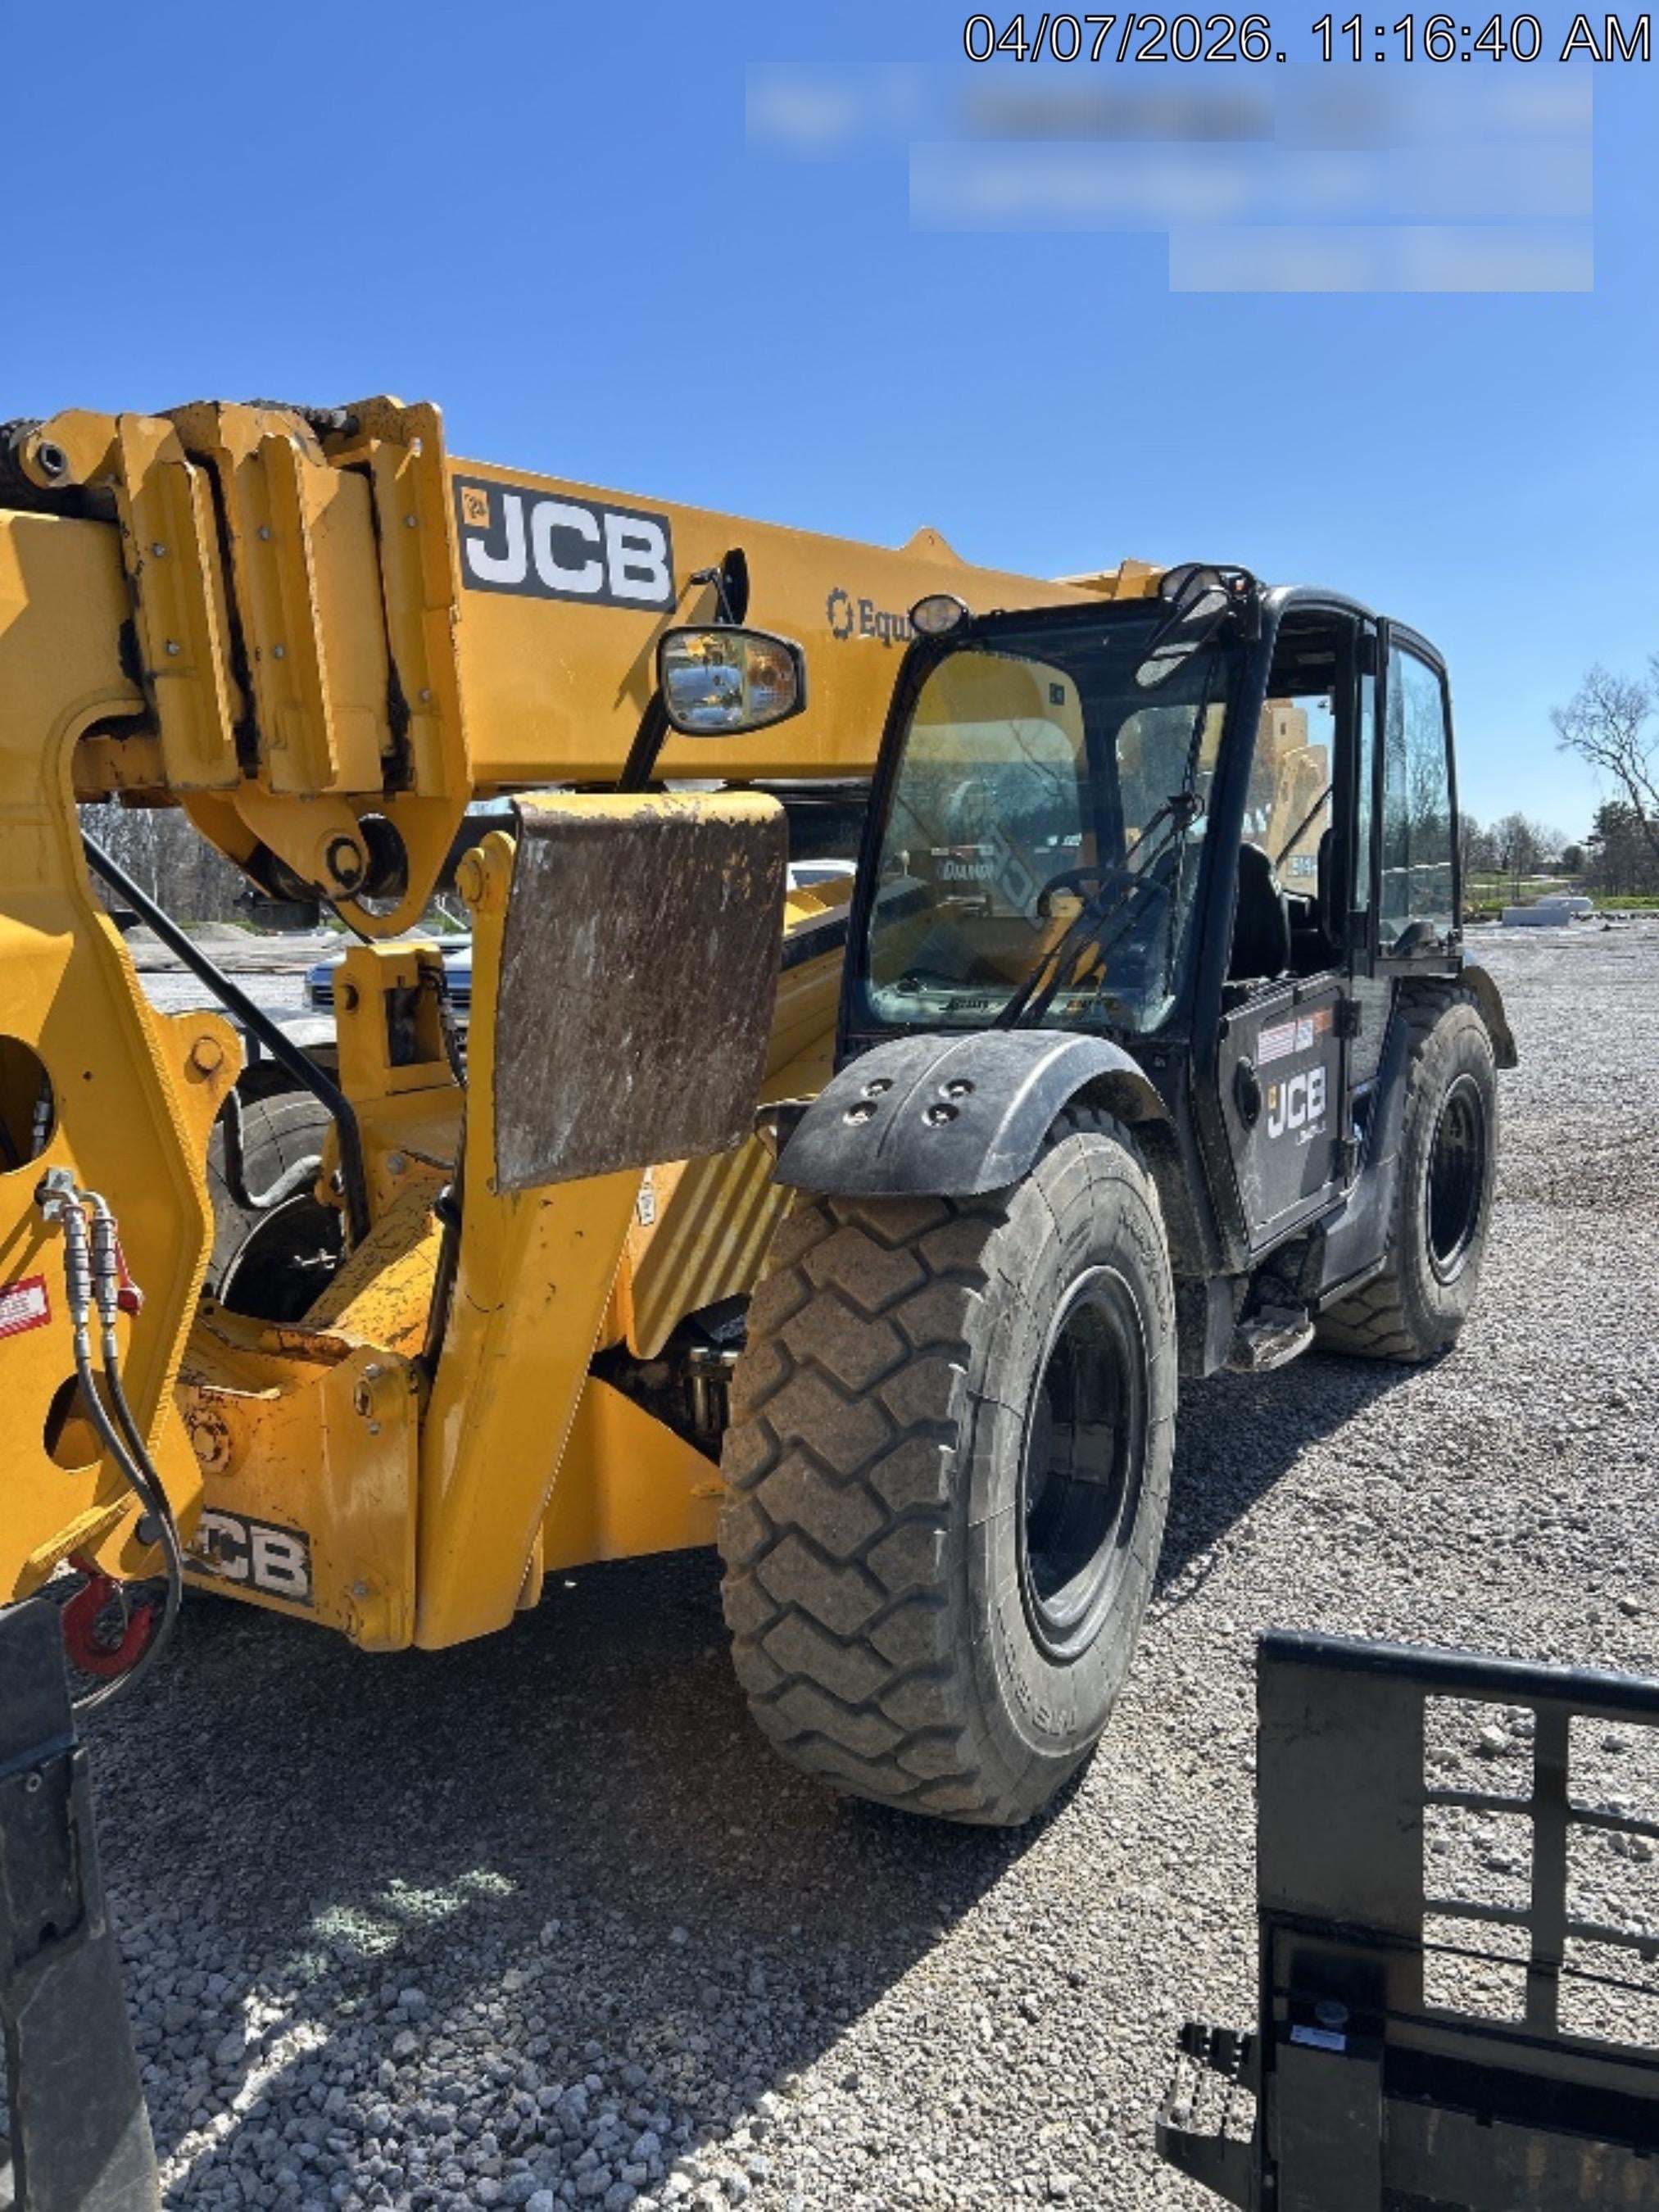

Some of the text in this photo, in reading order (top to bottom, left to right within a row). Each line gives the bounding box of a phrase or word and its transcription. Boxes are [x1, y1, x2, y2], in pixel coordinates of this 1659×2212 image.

[466, 494, 672, 602] JCB
[1267, 1066, 1326, 1139] JCB
[182, 1512, 308, 1597] CB
